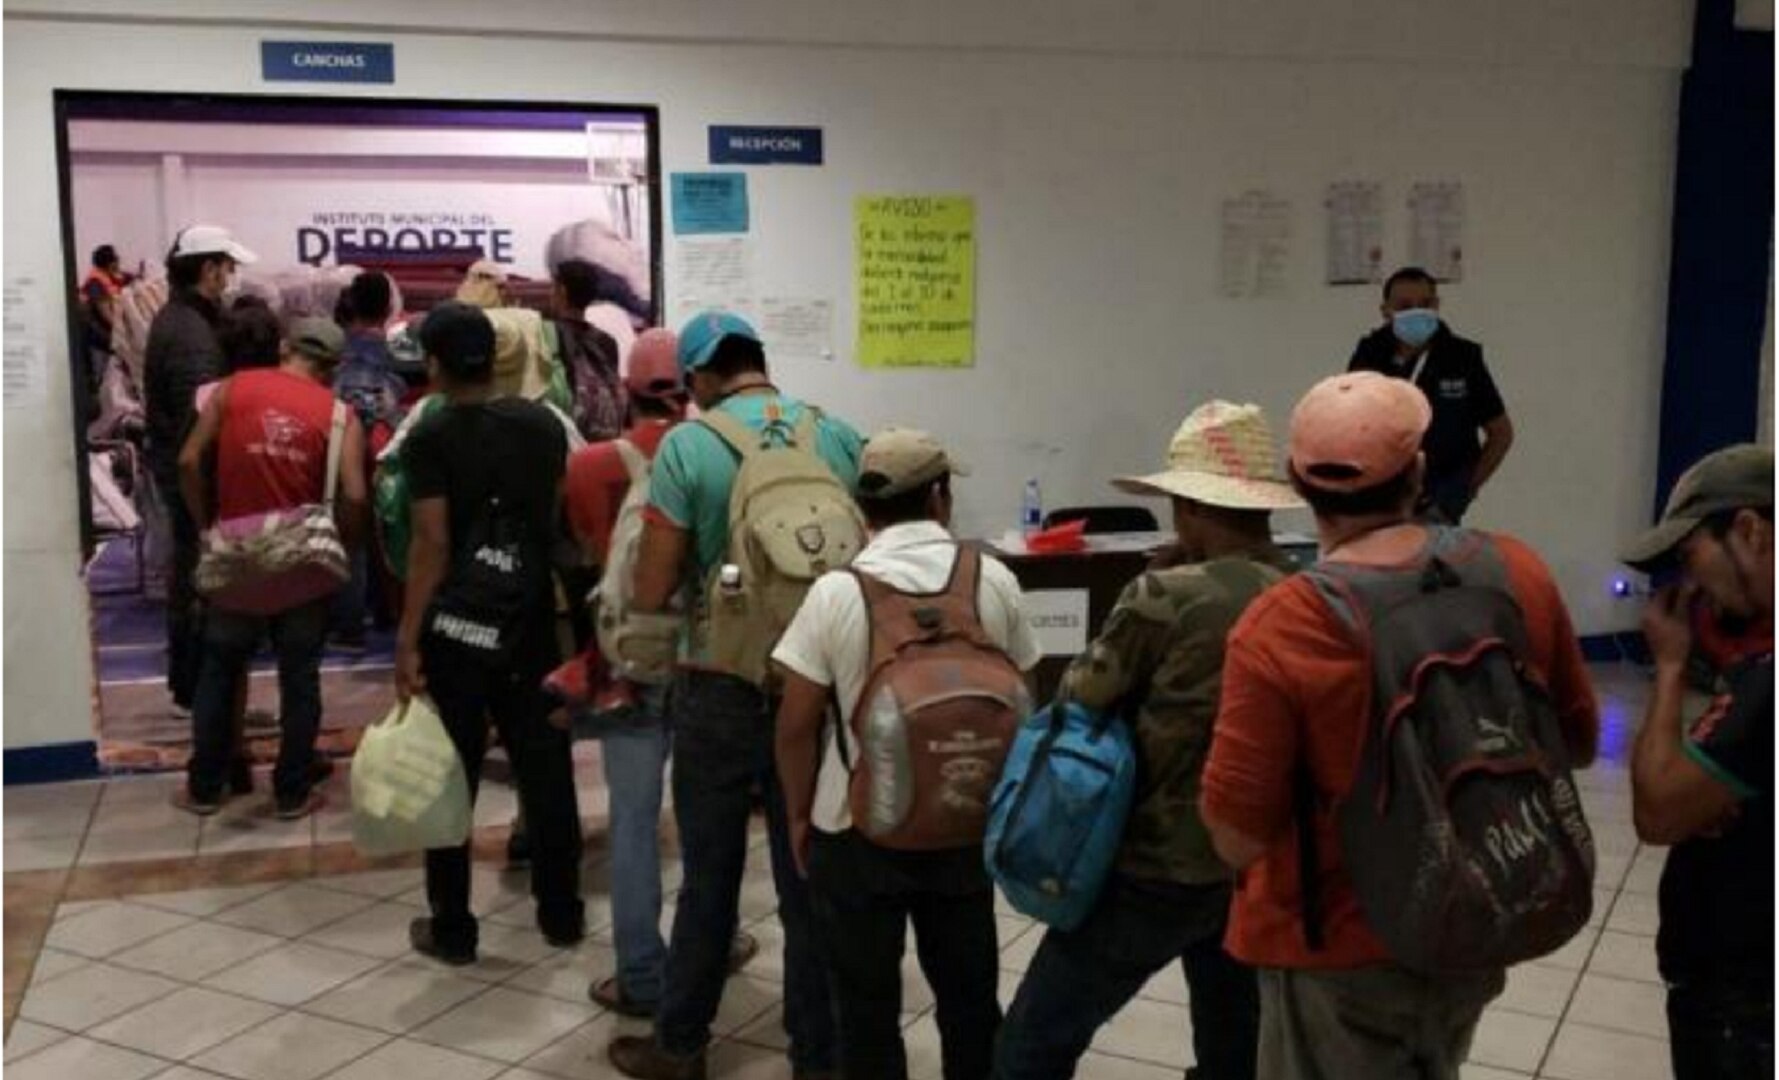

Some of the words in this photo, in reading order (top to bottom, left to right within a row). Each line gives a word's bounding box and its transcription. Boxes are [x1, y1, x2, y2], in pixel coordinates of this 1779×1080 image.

[293, 52, 366, 68] CANCHAS
[312, 211, 385, 225] INSTITUTO
[391, 211, 465, 225] MUNICIPAL
[471, 212, 495, 226] DEL
[296, 228, 515, 265] DEPORTE
